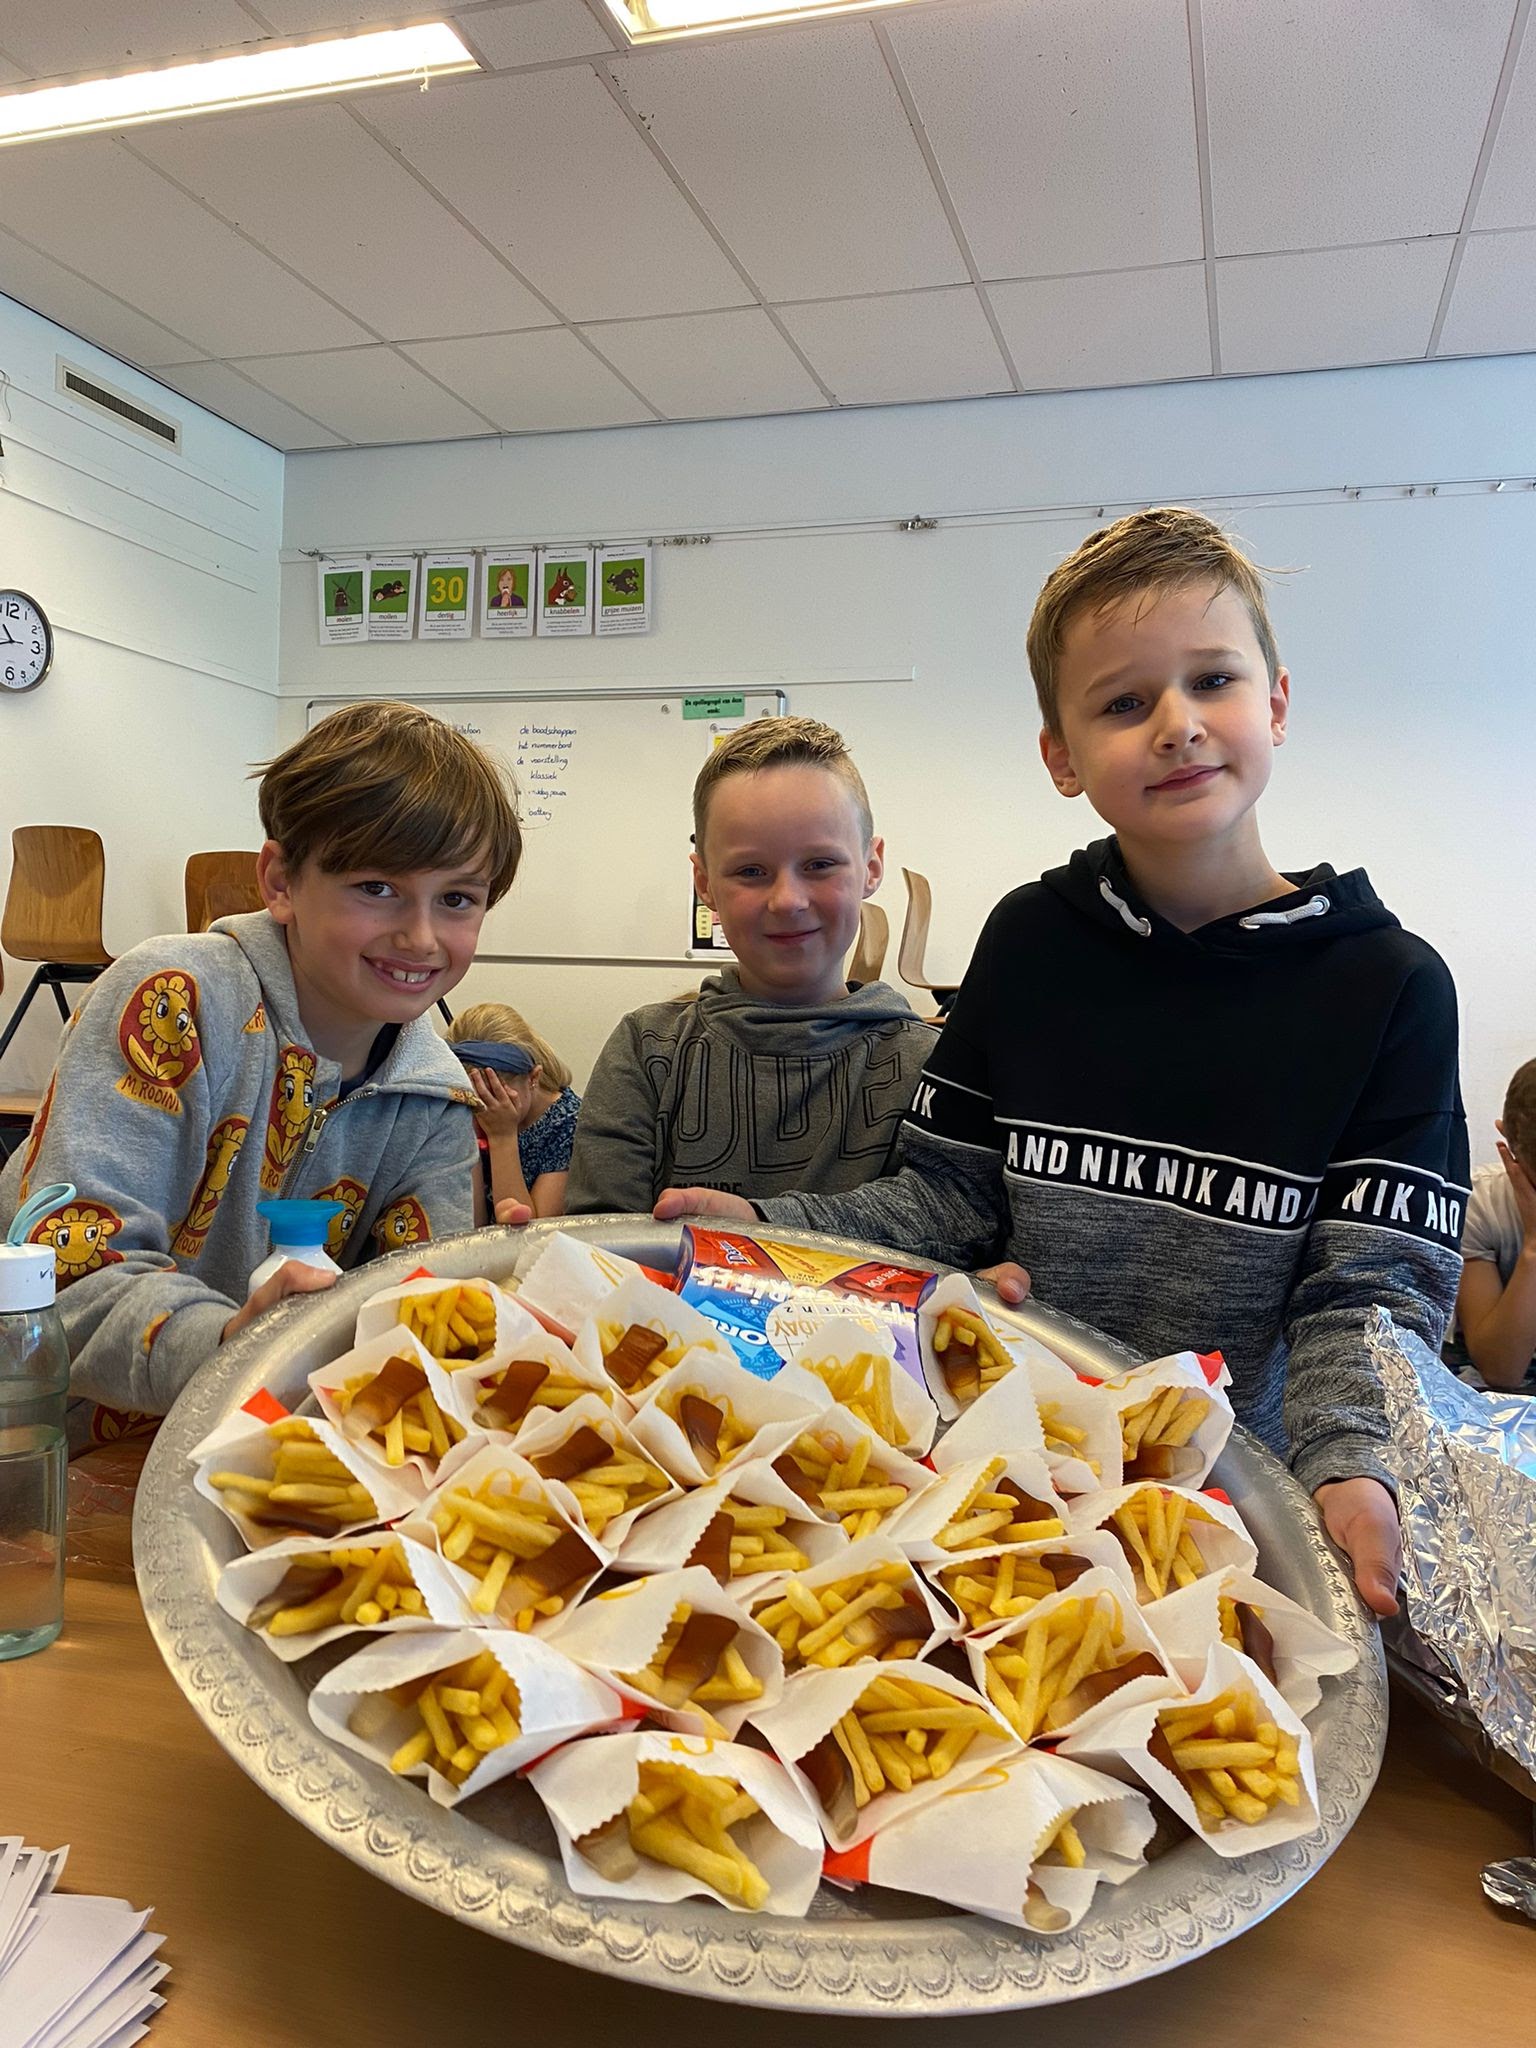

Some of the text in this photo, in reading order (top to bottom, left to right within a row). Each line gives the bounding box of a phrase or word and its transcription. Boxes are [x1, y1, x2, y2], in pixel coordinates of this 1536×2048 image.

[431, 576, 464, 604] 30
[6, 601, 20, 619] 12
[437, 611, 455, 620] dertig
[496, 610, 518, 618] heerlijk
[549, 607, 580, 615] knabbelen
[604, 607, 620, 616] grijze
[31, 625, 37, 634] 2
[31, 640, 40, 654] 3
[29, 660, 36, 668] 4
[5, 666, 15, 680] 6
[20, 670, 26, 679] 5
[519, 724, 577, 737] de boodschappen
[518, 741, 573, 750] het nummerbord
[516, 755, 568, 771] de voorstelling
[530, 771, 558, 780] klassiek
[911, 1081, 937, 1119] IK
[1006, 1131, 1069, 1175] AND
[1079, 1143, 1147, 1190] NIK
[1155, 1156, 1218, 1206] NIK
[1223, 1176, 1302, 1223] AND
[1341, 1177, 1415, 1222] NIK
